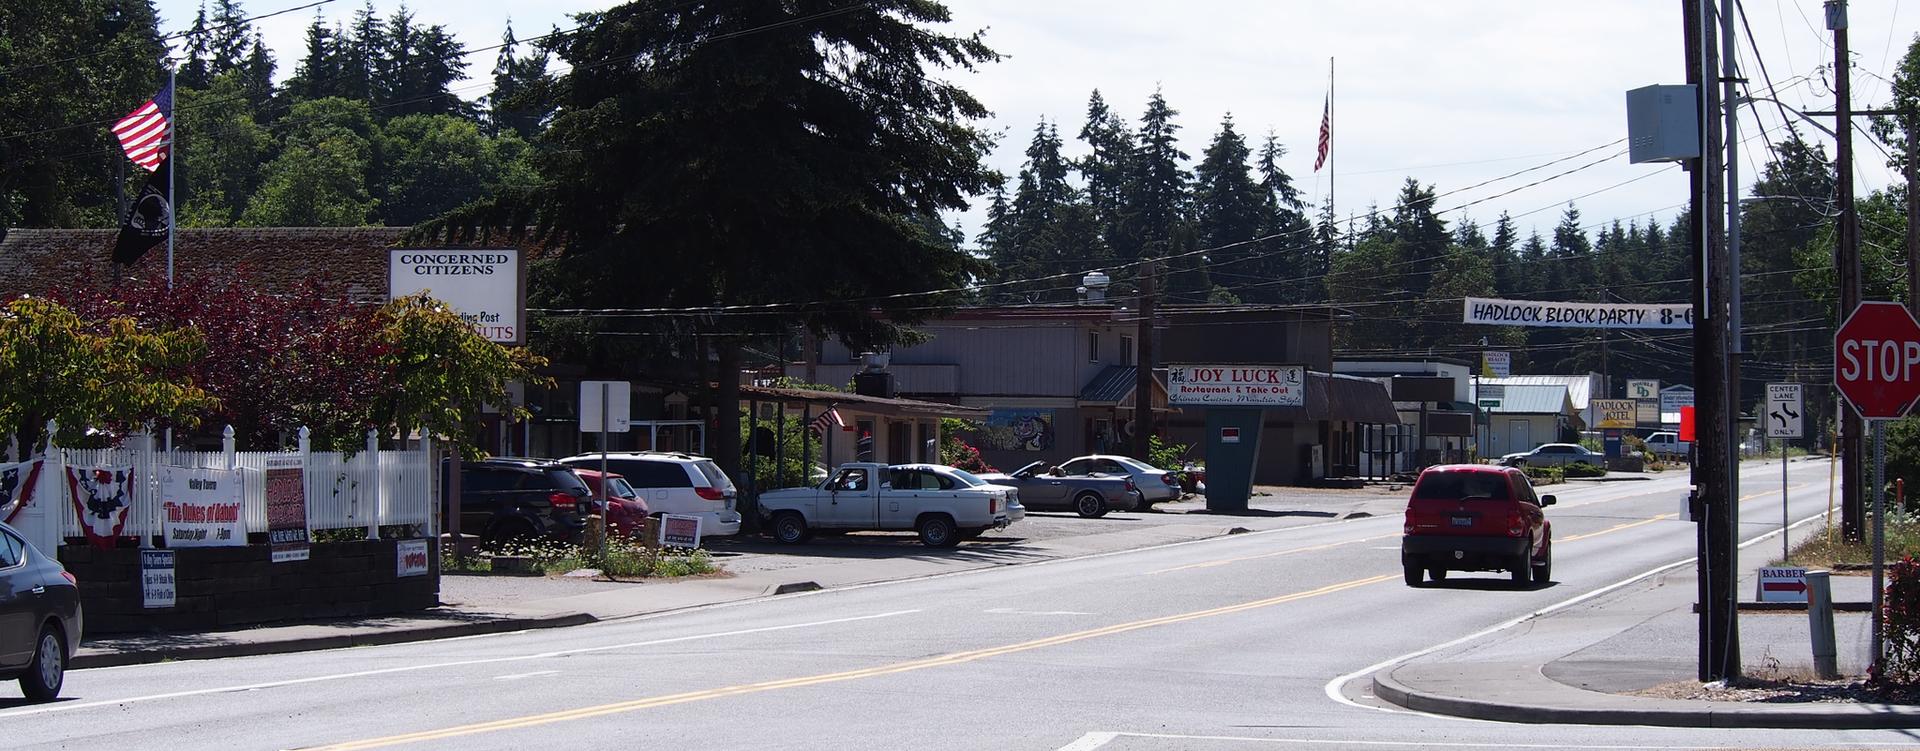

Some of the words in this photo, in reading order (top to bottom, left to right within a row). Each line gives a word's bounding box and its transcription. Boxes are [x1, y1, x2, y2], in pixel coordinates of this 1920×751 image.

[400, 254, 508, 265] CONCERNED
[414, 265, 494, 275] CITIZENS
[480, 311, 500, 322] Post
[1473, 303, 1543, 321] HADLOCK
[1545, 307, 1597, 324] BLOCK
[1599, 308, 1646, 325] PARTY
[1841, 338, 1920, 382] STOP
[1189, 368, 1224, 383] JOY
[1231, 369, 1280, 384] LUCK
[1180, 385, 1231, 394] Restaurant
[1235, 386, 1241, 394] &
[1246, 386, 1269, 394] Take
[1271, 386, 1289, 394] Out
[182, 502, 205, 523] Dukes
[1762, 569, 1807, 578] BARBER
